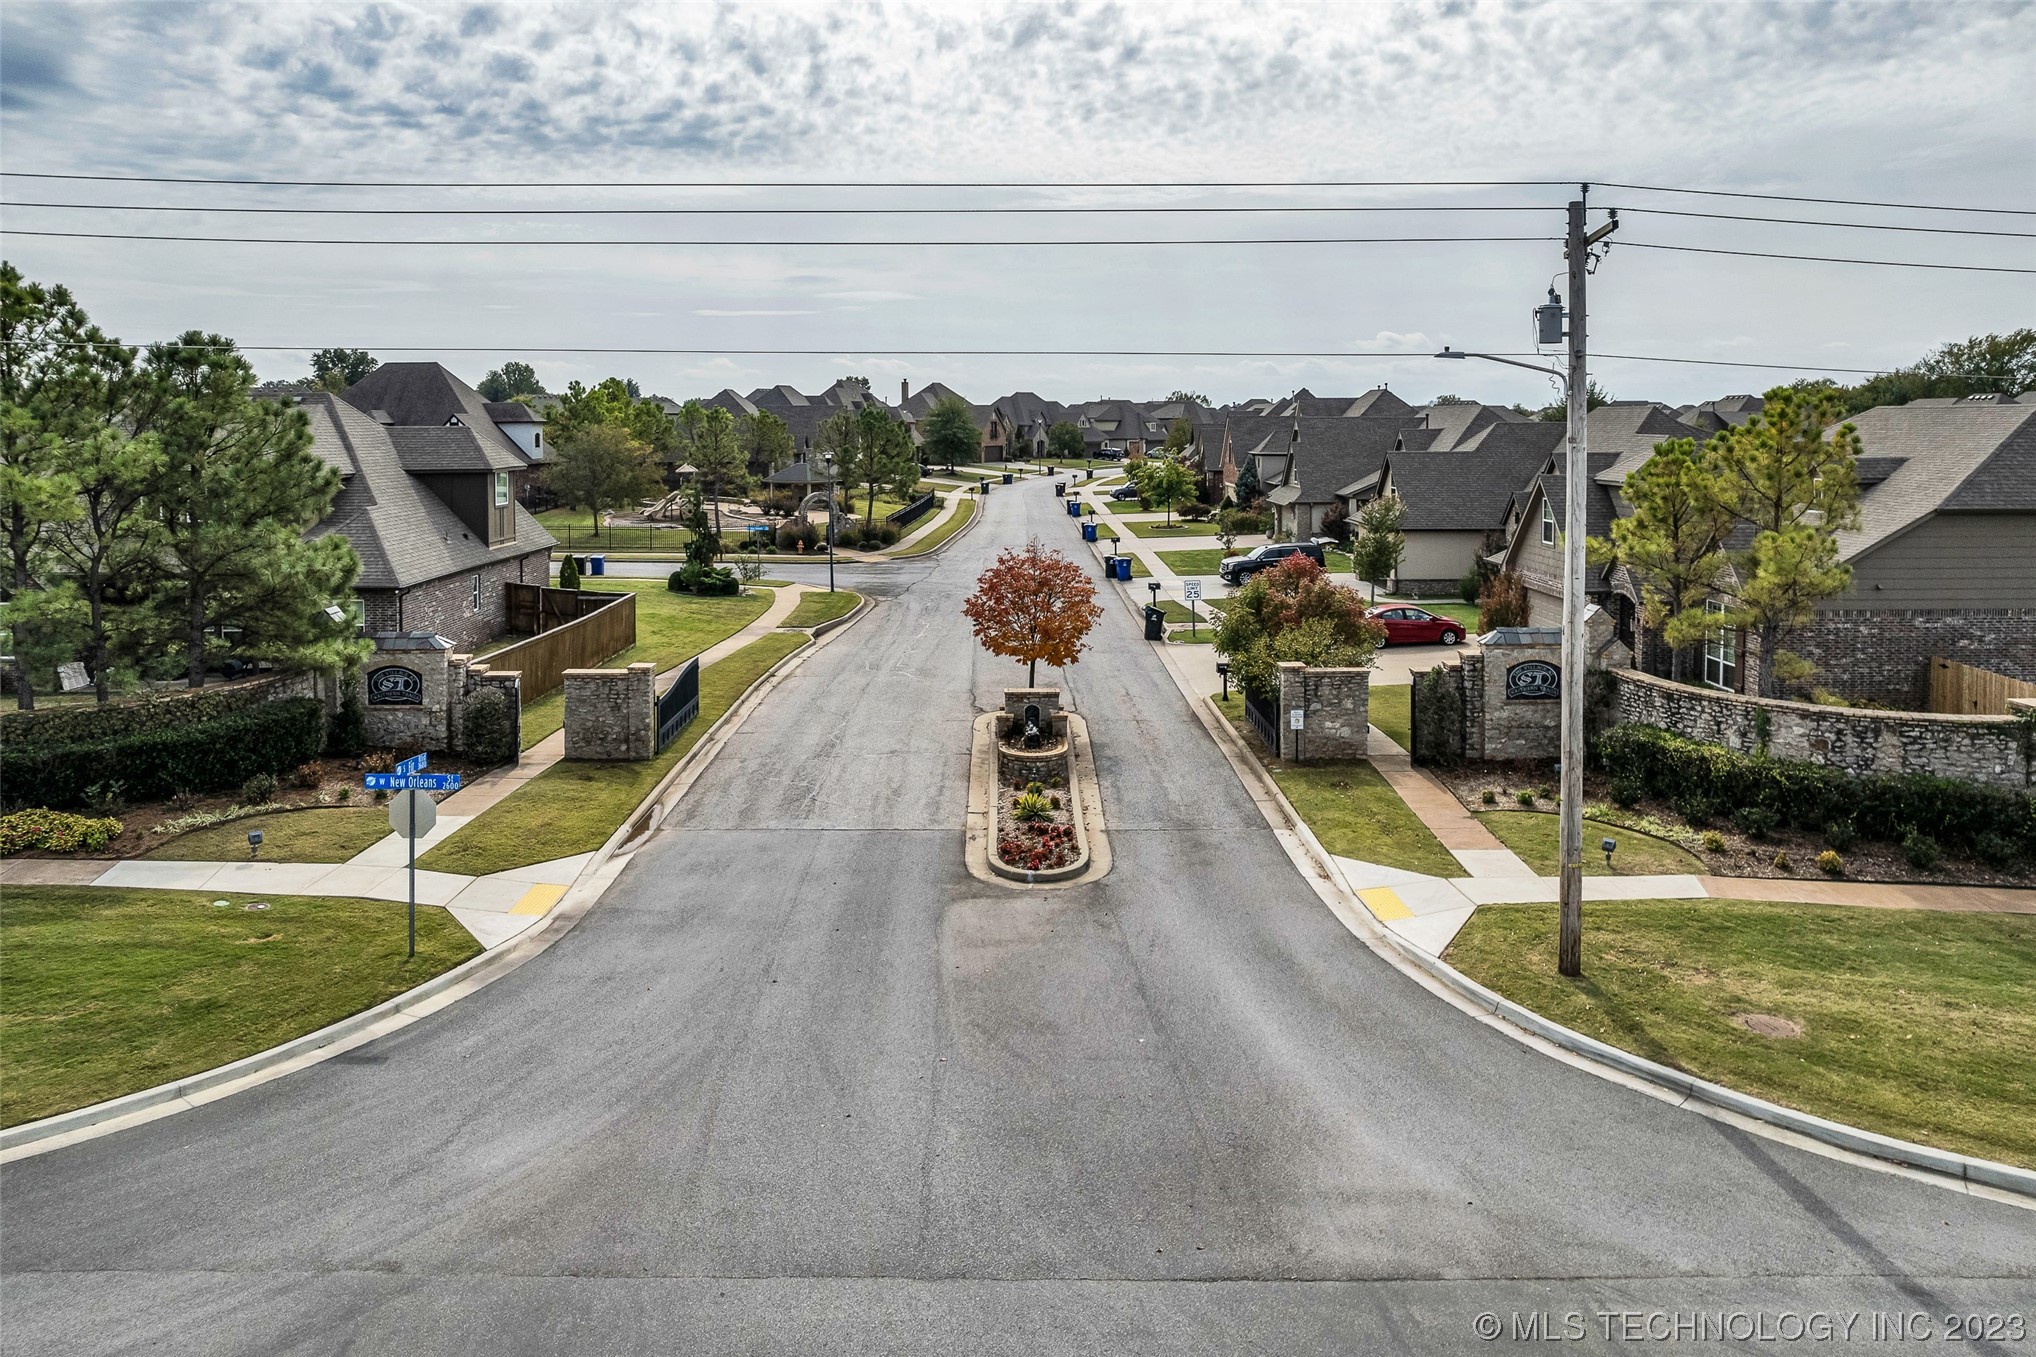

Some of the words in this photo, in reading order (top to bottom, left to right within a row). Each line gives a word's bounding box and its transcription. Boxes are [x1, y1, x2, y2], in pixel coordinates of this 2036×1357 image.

[1186, 590, 1200, 599] 25
[390, 776, 406, 788] New
[408, 776, 437, 788] Orleans
[447, 774, 454, 783] St
[442, 782, 459, 790] 2600
